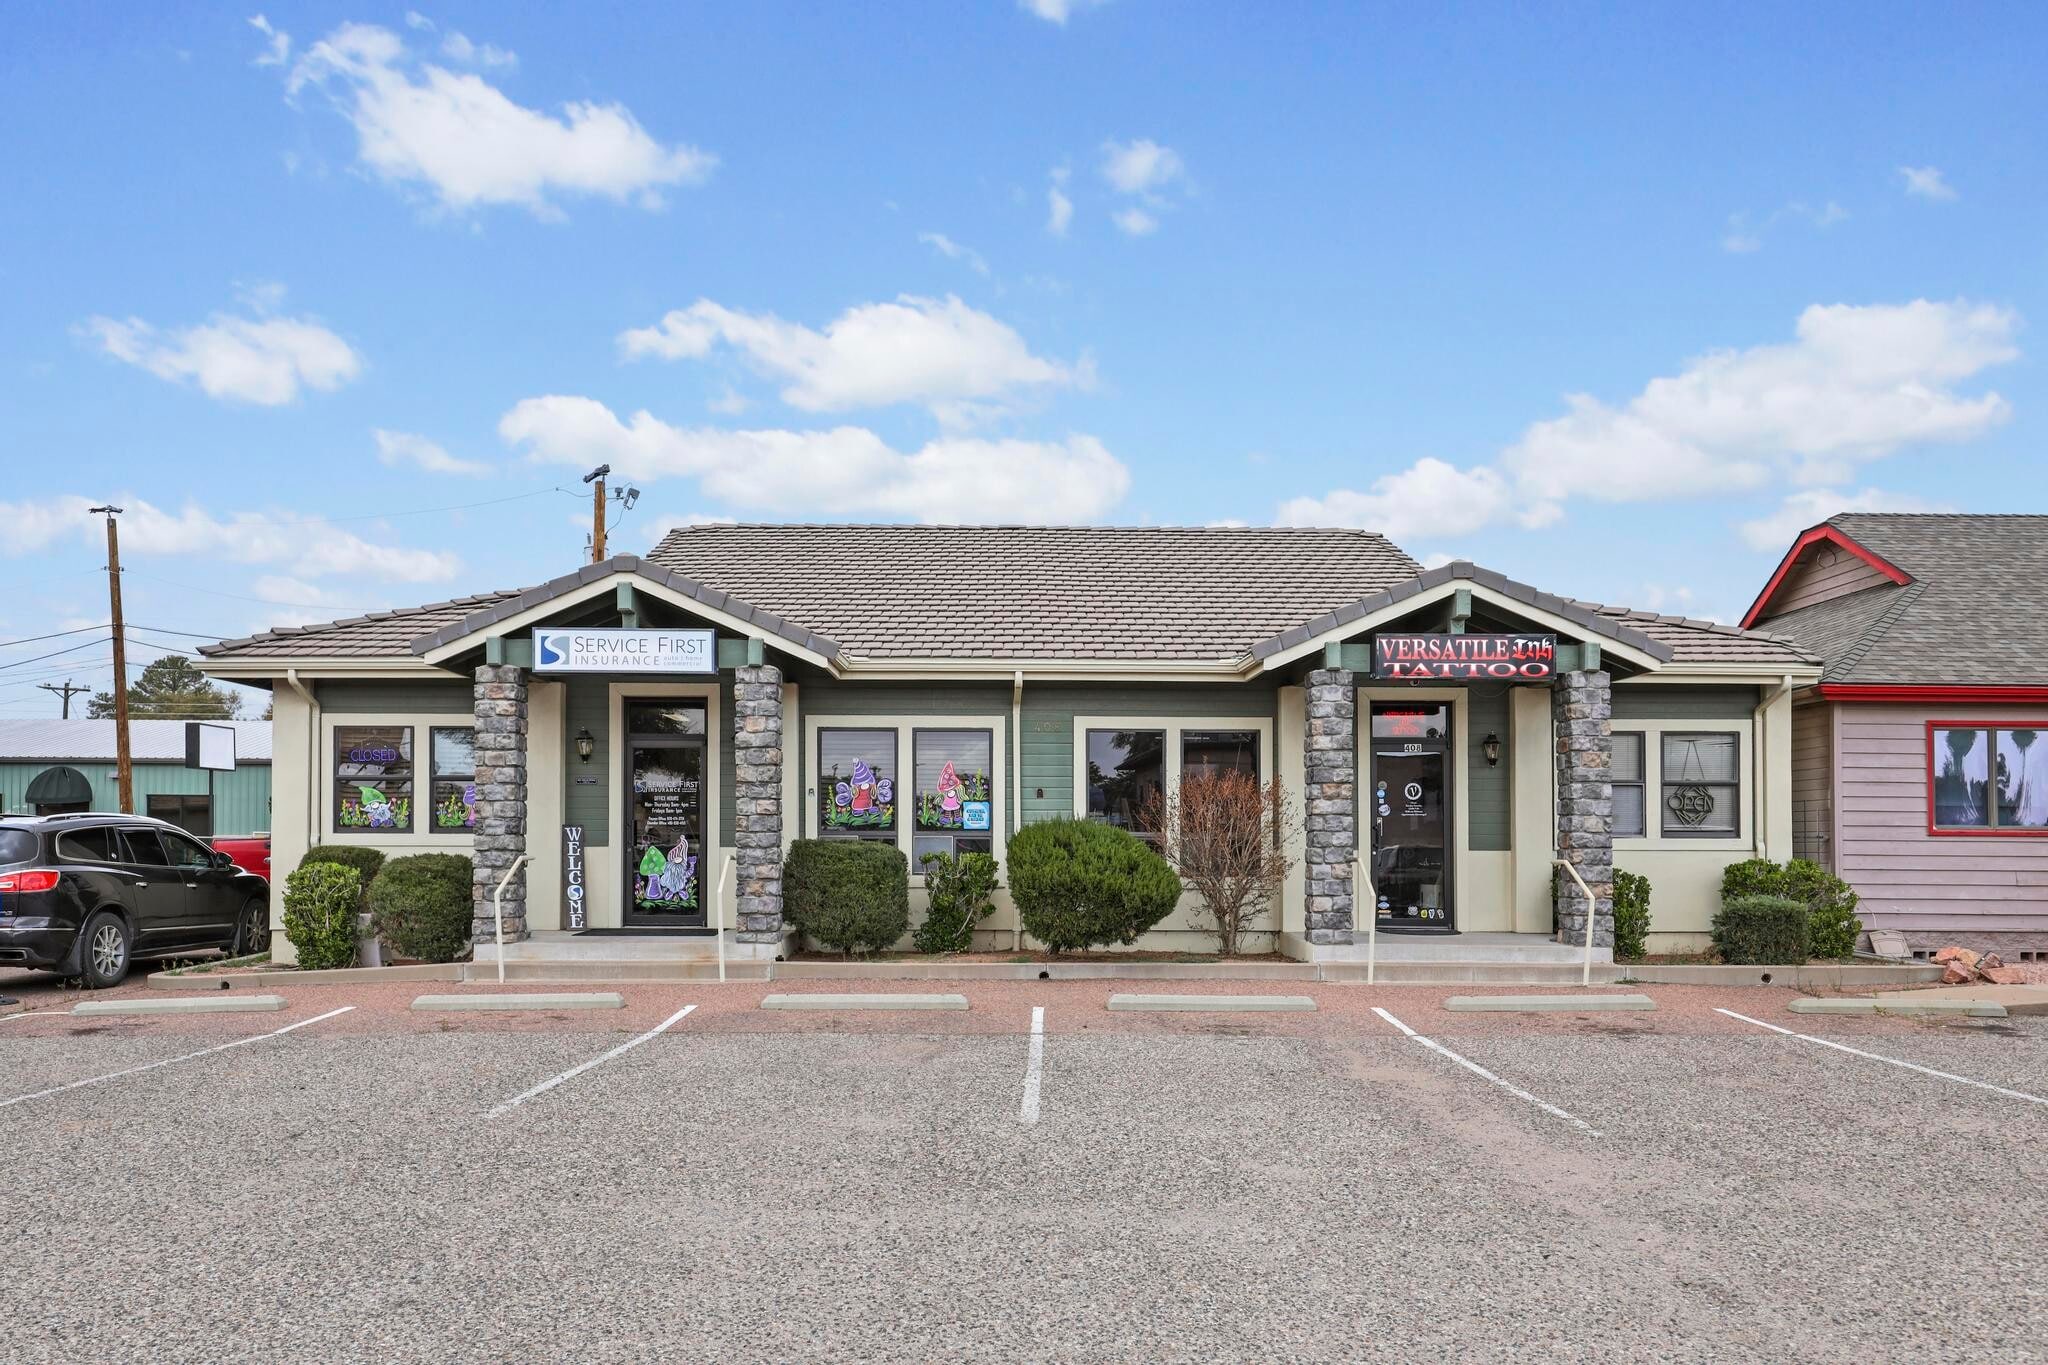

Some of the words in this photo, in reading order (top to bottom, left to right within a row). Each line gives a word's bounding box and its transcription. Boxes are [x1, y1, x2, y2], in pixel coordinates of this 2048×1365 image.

[574, 636, 648, 653] SERVICE
[658, 636, 706, 654] FIRST
[1379, 638, 1510, 660] VERSATILE
[1512, 637, 1553, 661] Ink
[574, 655, 660, 665] INSURANCE
[1383, 663, 1550, 677] TATTOO
[350, 749, 397, 762] CLOSED
[1404, 744, 1422, 752] 408
[1668, 795, 1714, 812] OPEN
[565, 827, 584, 929] WELCOME
